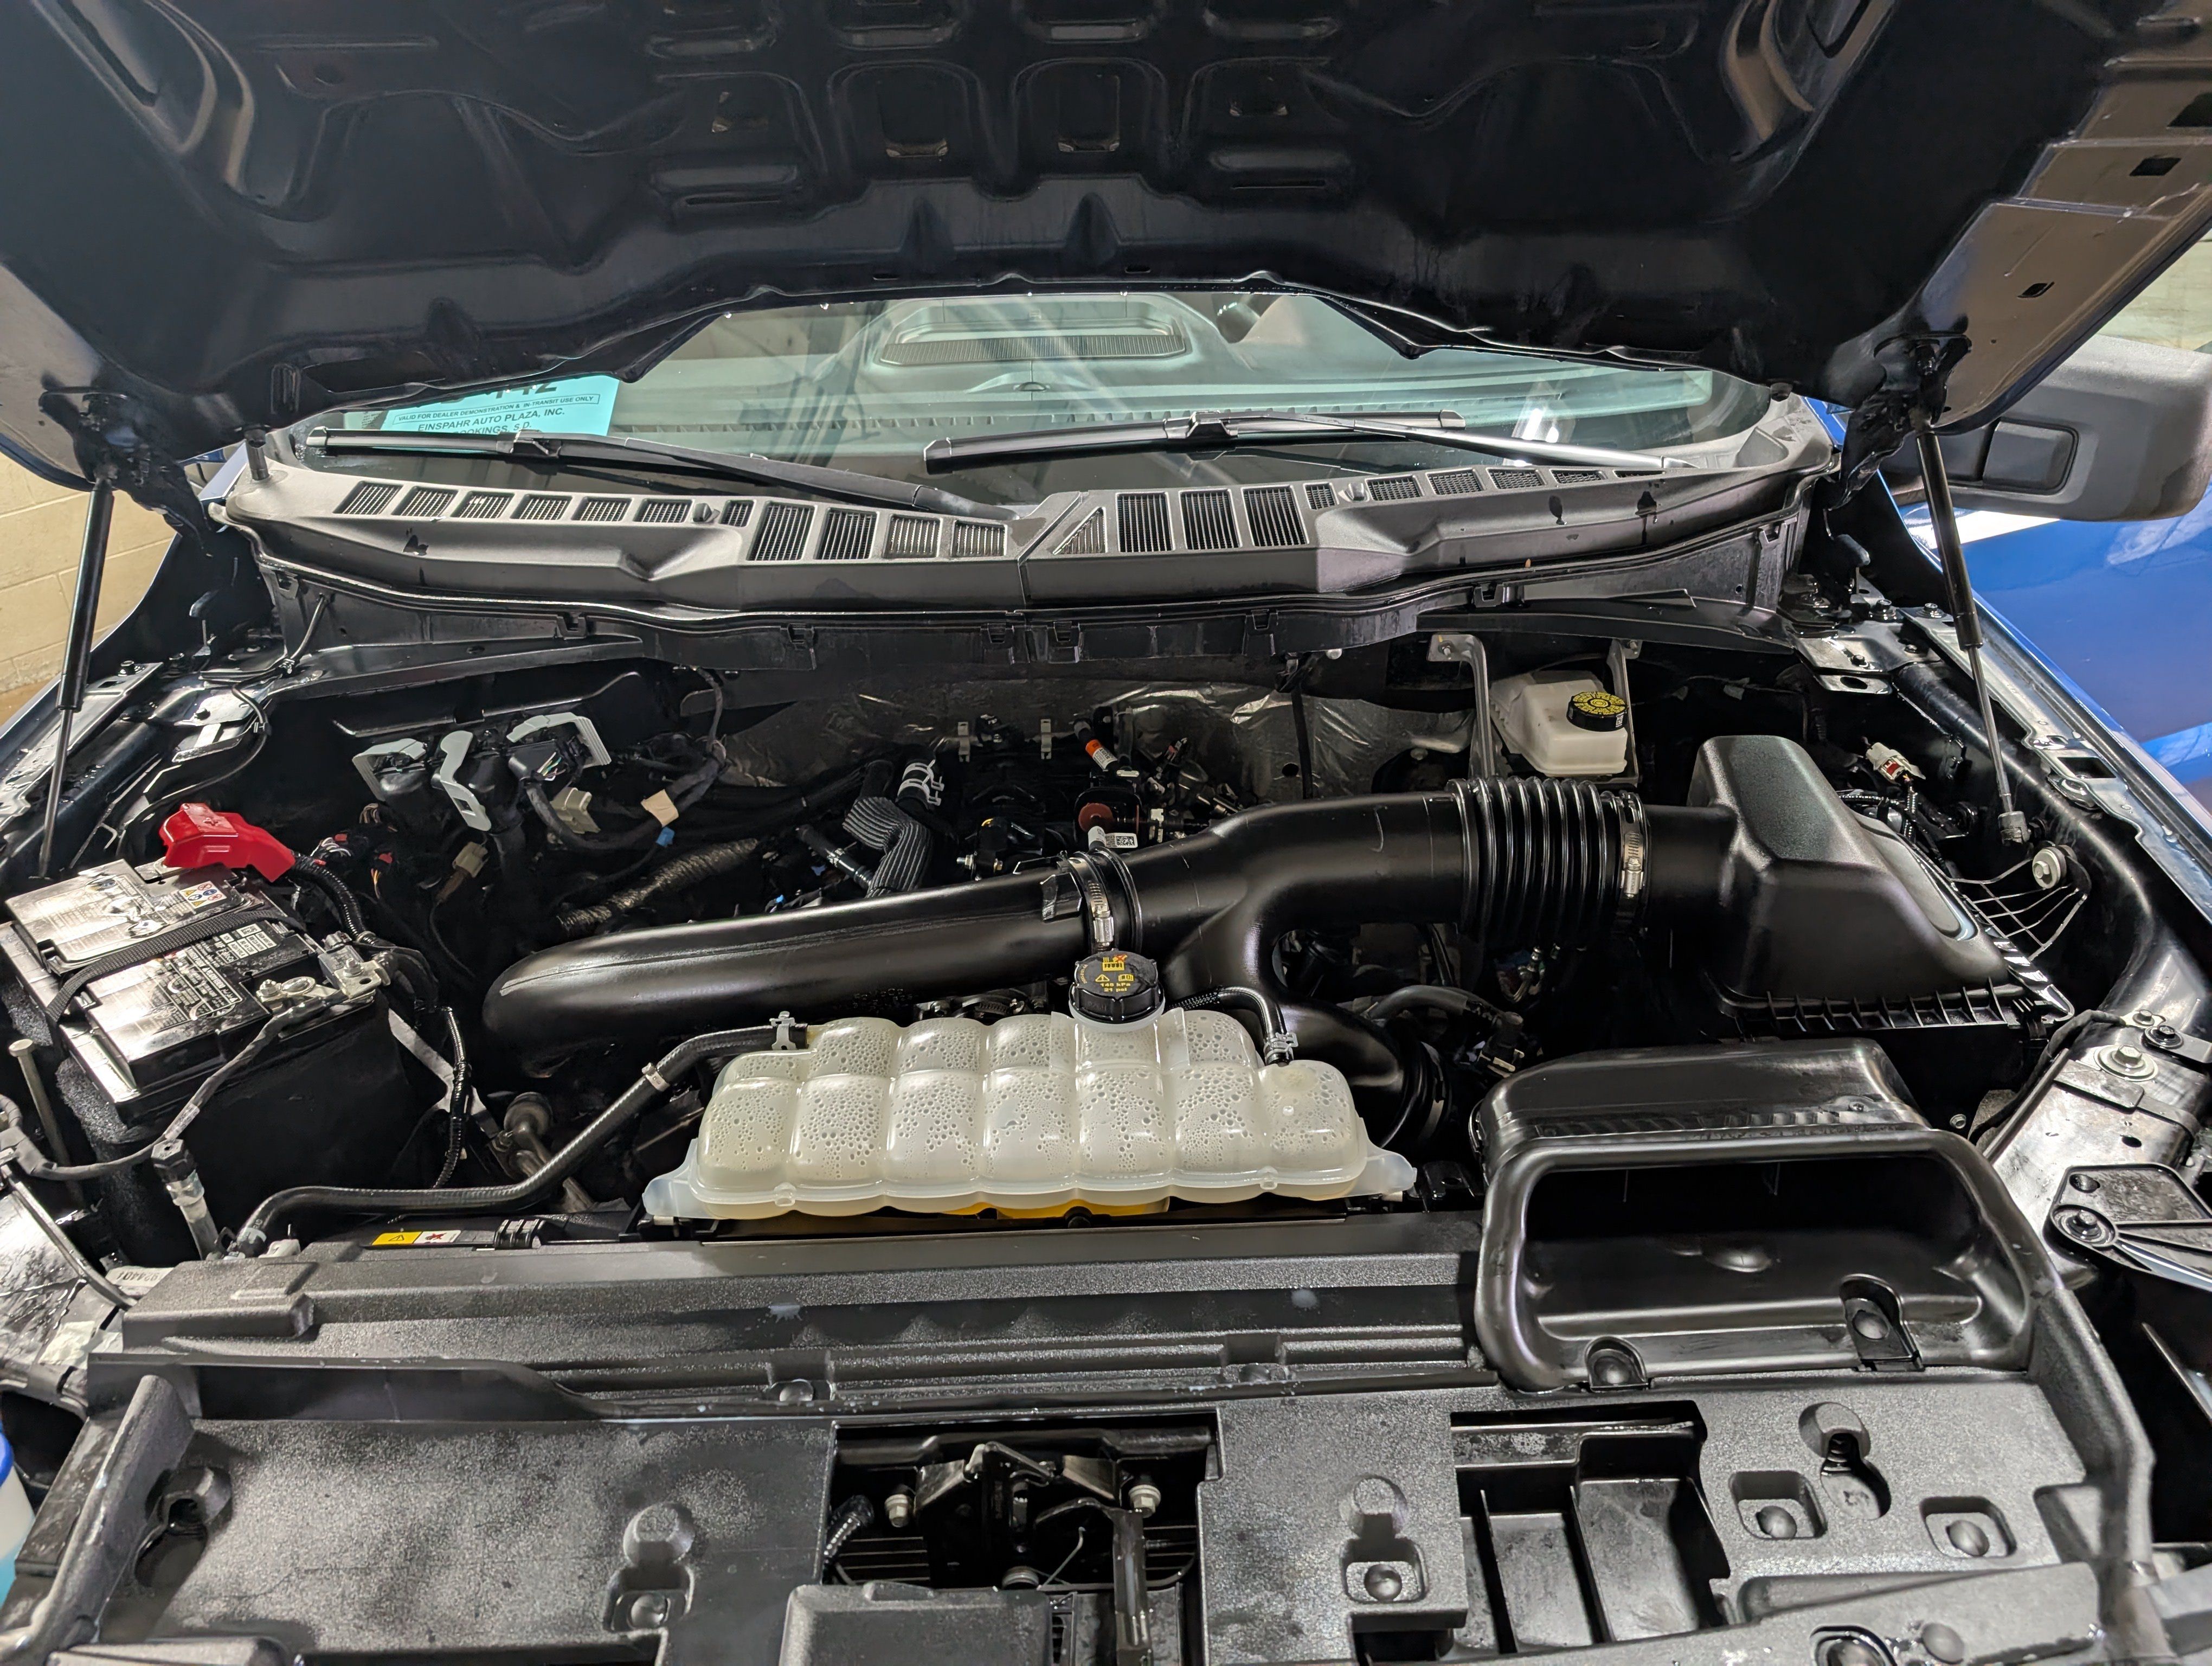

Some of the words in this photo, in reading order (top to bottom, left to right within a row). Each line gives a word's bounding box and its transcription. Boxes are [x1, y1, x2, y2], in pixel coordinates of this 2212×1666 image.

[460, 405, 514, 416] DEMONSTRATION
[523, 399, 558, 407] IN-TRANSIT
[417, 420, 470, 431] EINSPAHR
[472, 415, 501, 426] AUTO
[504, 411, 541, 422] PLAZA,
[544, 408, 565, 416] INC.
